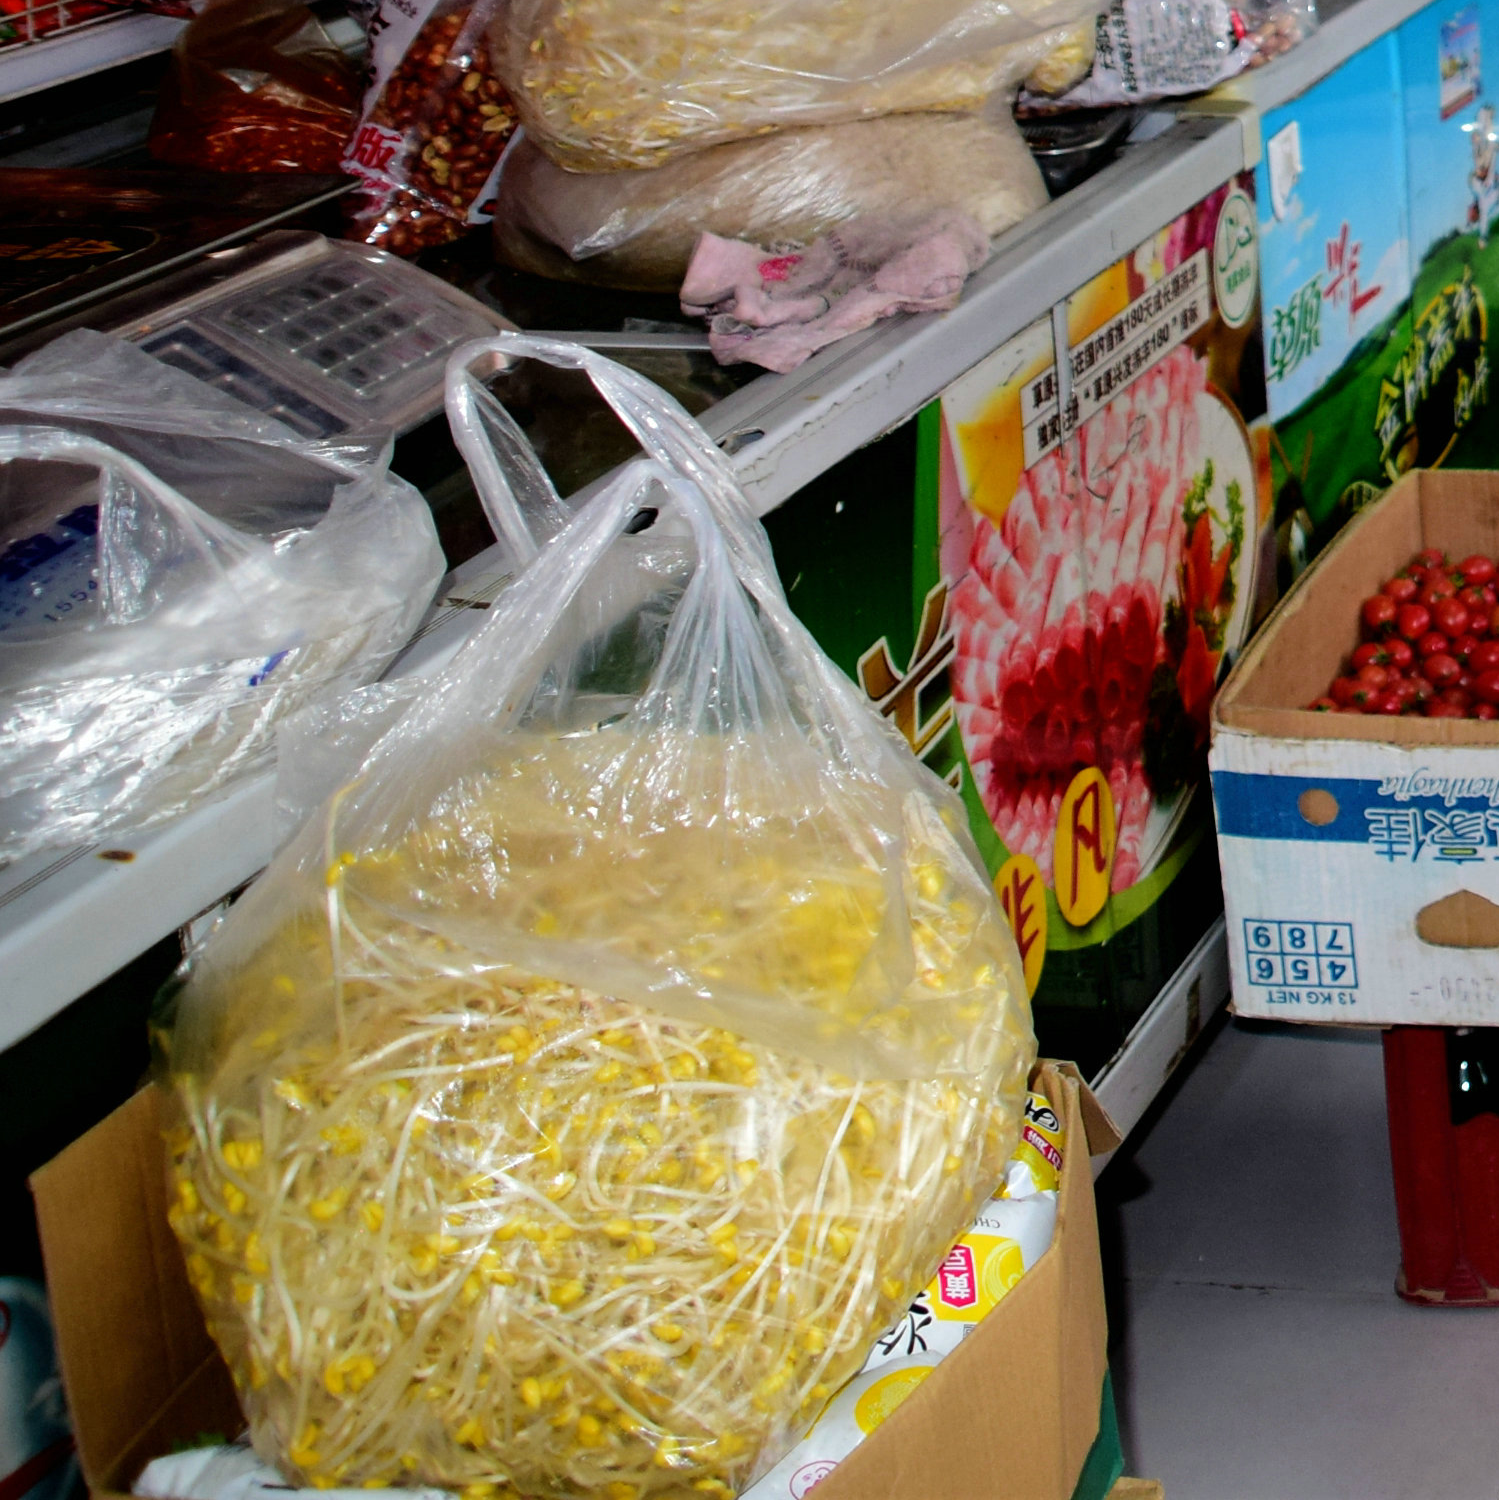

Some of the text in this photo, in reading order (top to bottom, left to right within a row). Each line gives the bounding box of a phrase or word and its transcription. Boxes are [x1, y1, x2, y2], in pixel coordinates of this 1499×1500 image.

[1254, 928, 1344, 950] 9 8 7
[1256, 960, 1346, 982] 6 5 4
[1266, 991, 1357, 1005] 13 KG NET
